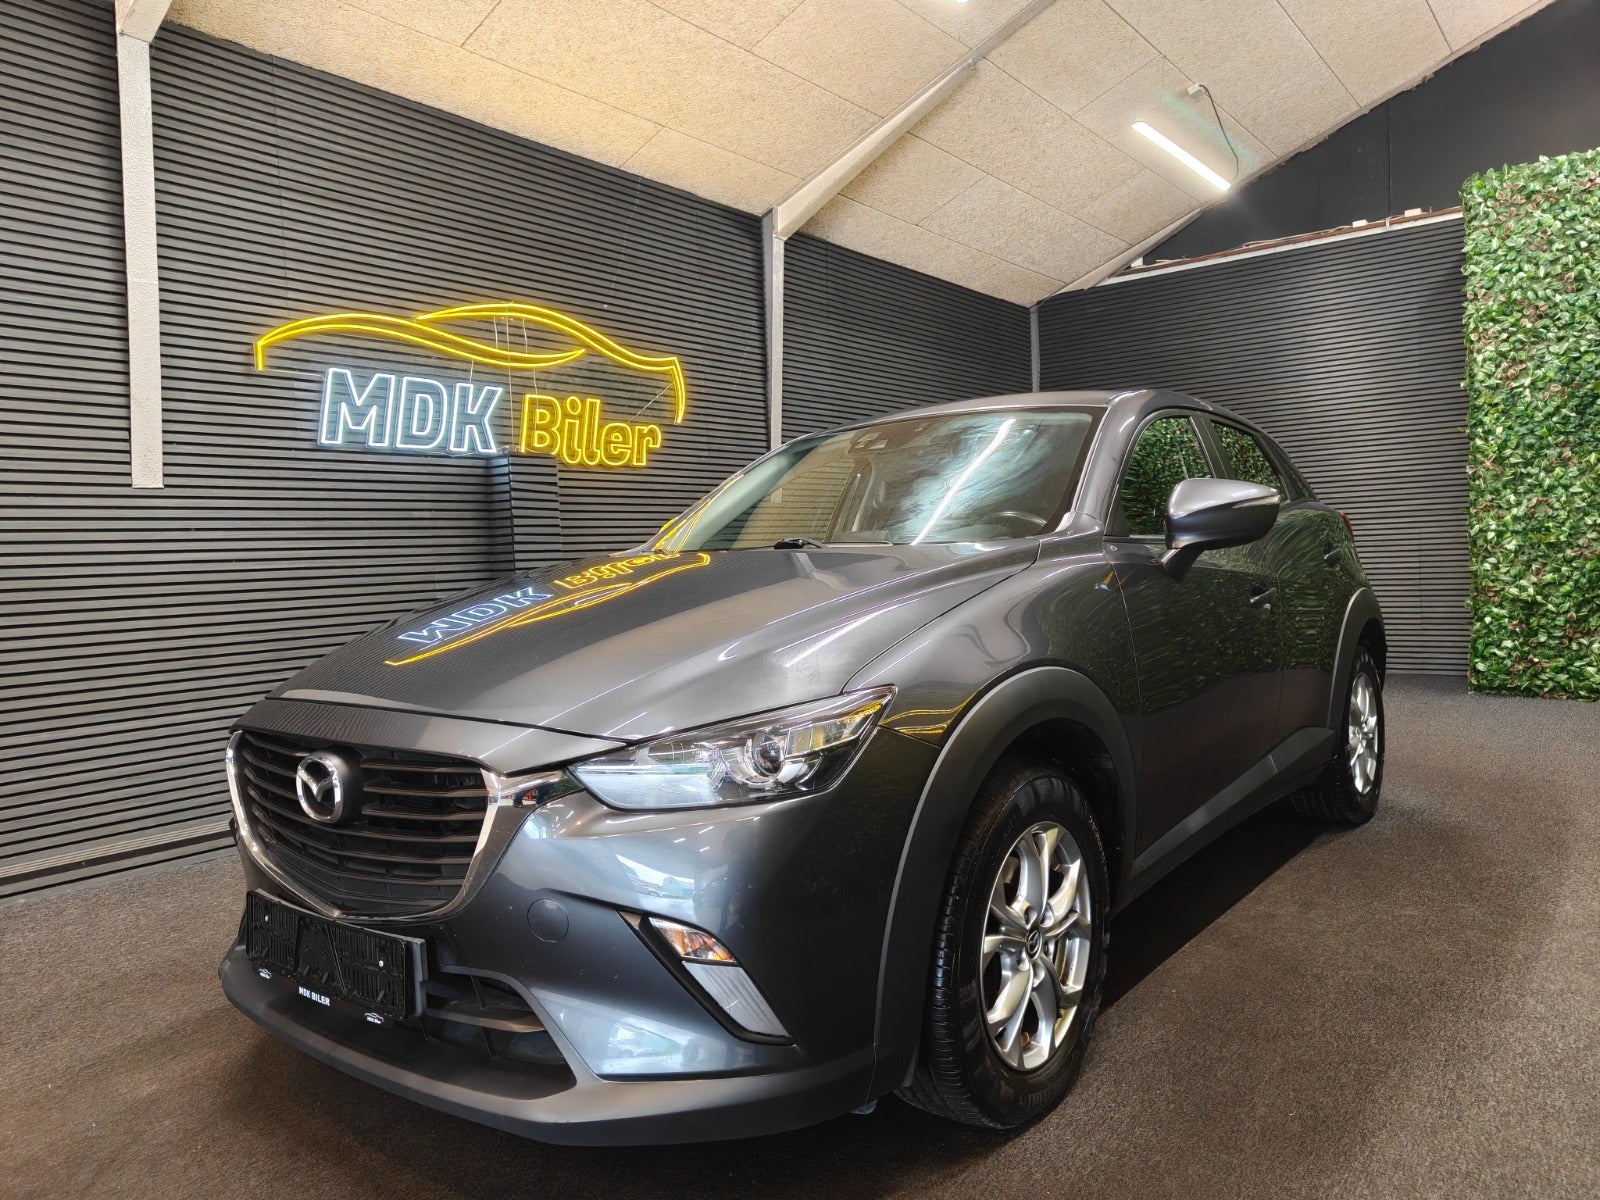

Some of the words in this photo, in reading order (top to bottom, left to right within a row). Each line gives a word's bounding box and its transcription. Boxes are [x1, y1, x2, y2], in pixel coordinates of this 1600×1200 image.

[317, 367, 502, 455] MDK
[519, 393, 662, 467] Biler
[298, 985, 311, 998] MDK
[311, 991, 331, 1007] BILER
